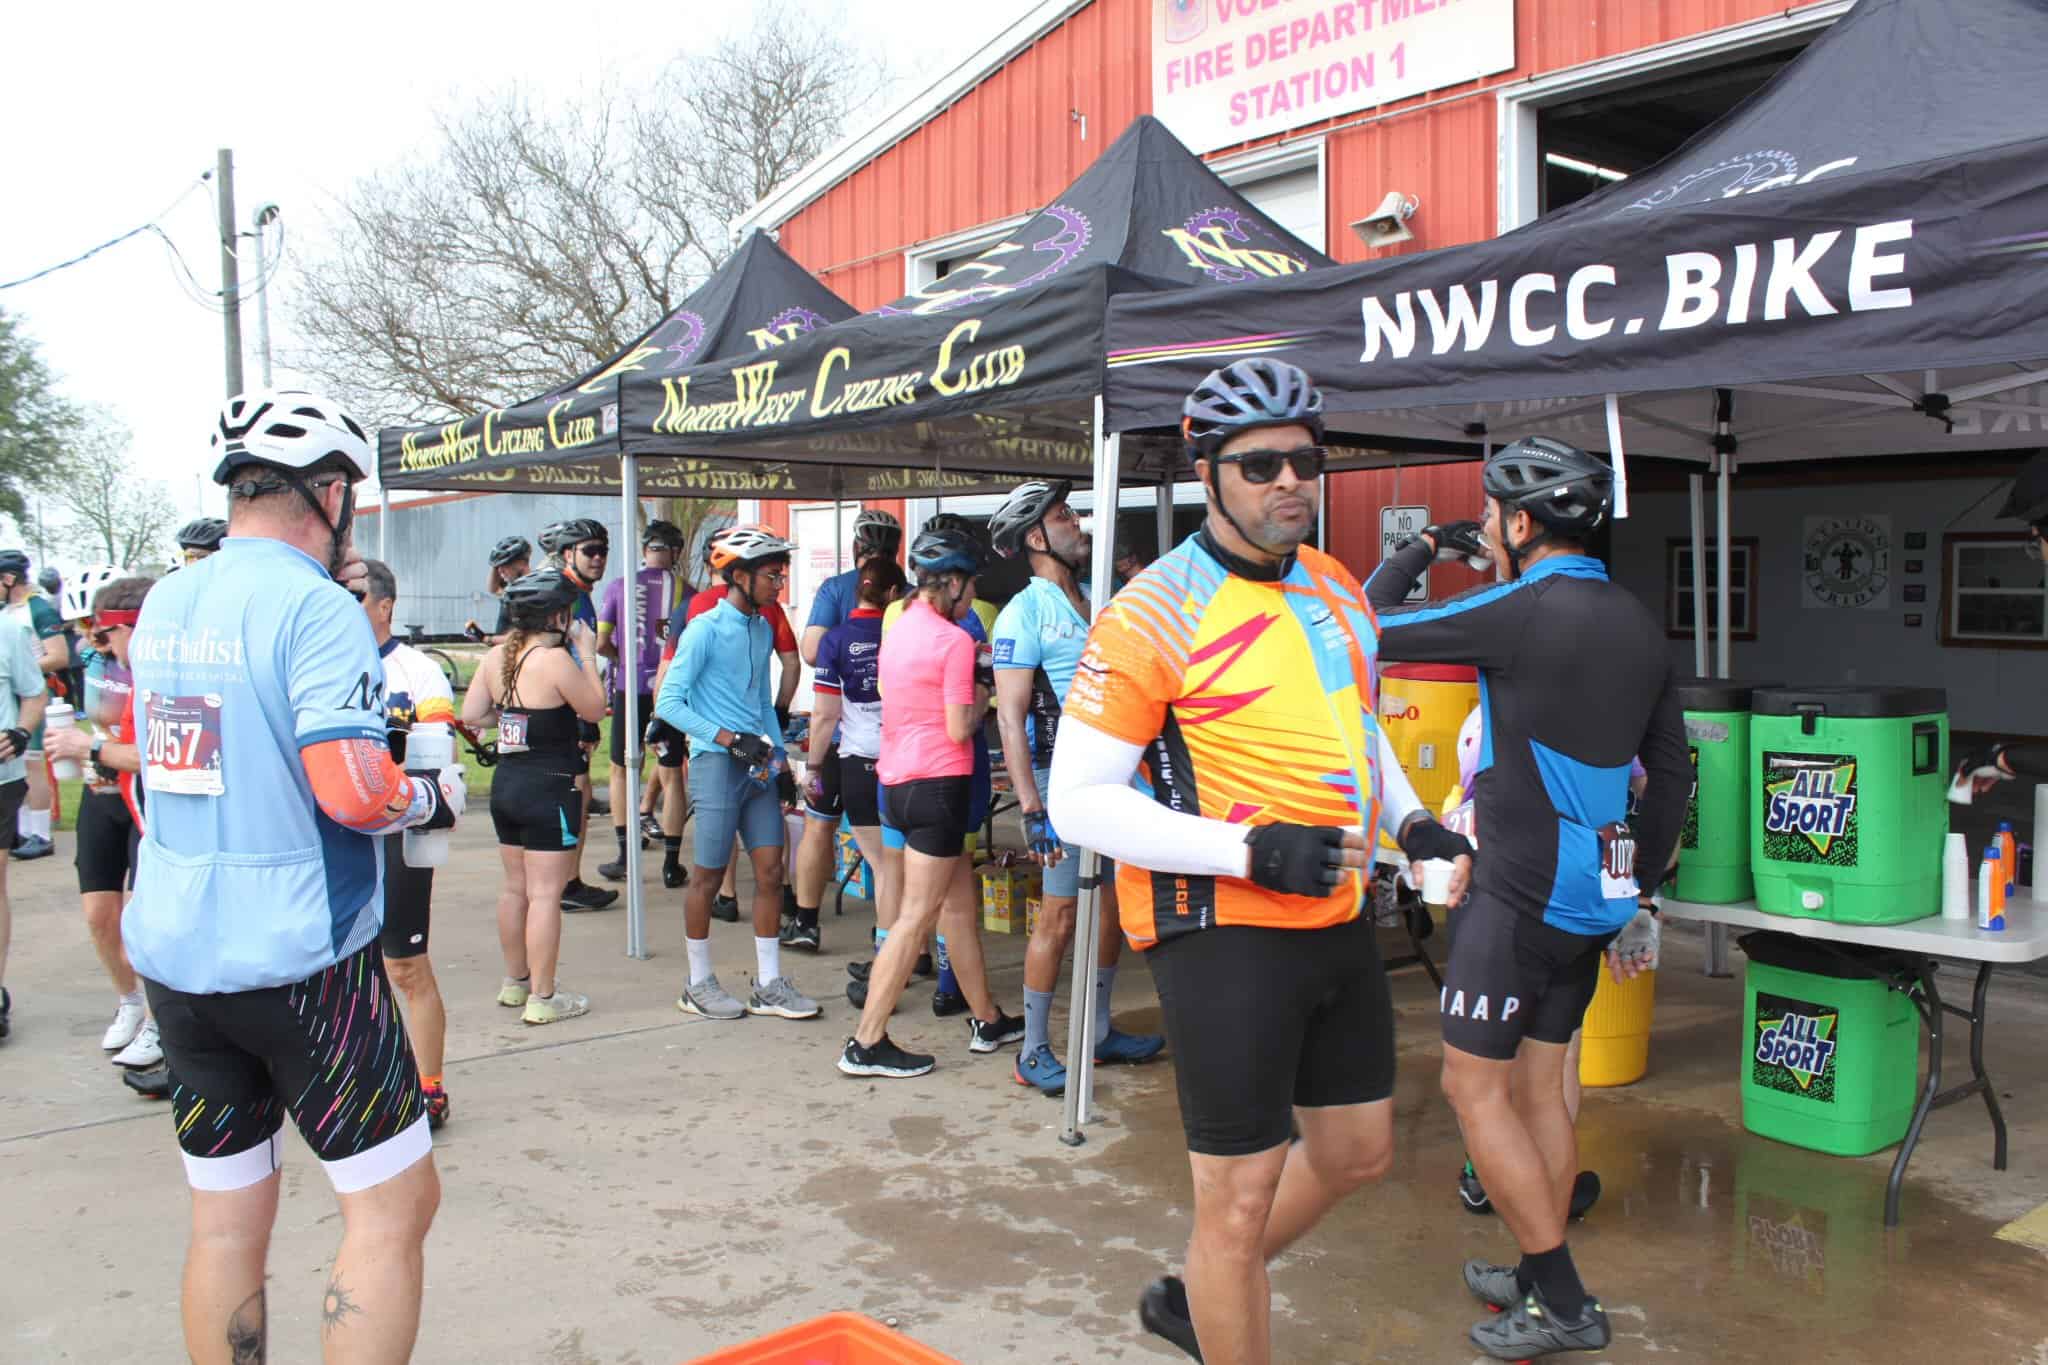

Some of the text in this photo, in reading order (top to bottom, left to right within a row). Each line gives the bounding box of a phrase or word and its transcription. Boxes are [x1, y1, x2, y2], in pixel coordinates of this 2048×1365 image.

[1166, 42, 1234, 94] FIRE
[1229, 41, 1406, 127] STATION 1
[1360, 218, 1913, 363] NWCC.BIKE
[1398, 516, 1413, 530] NO
[146, 718, 202, 766] 2057
[1790, 769, 1836, 801] ALL
[1766, 791, 1855, 837] SPORT
[1756, 1027, 1834, 1076] SPORT
[1778, 1012, 1818, 1045] ALL
